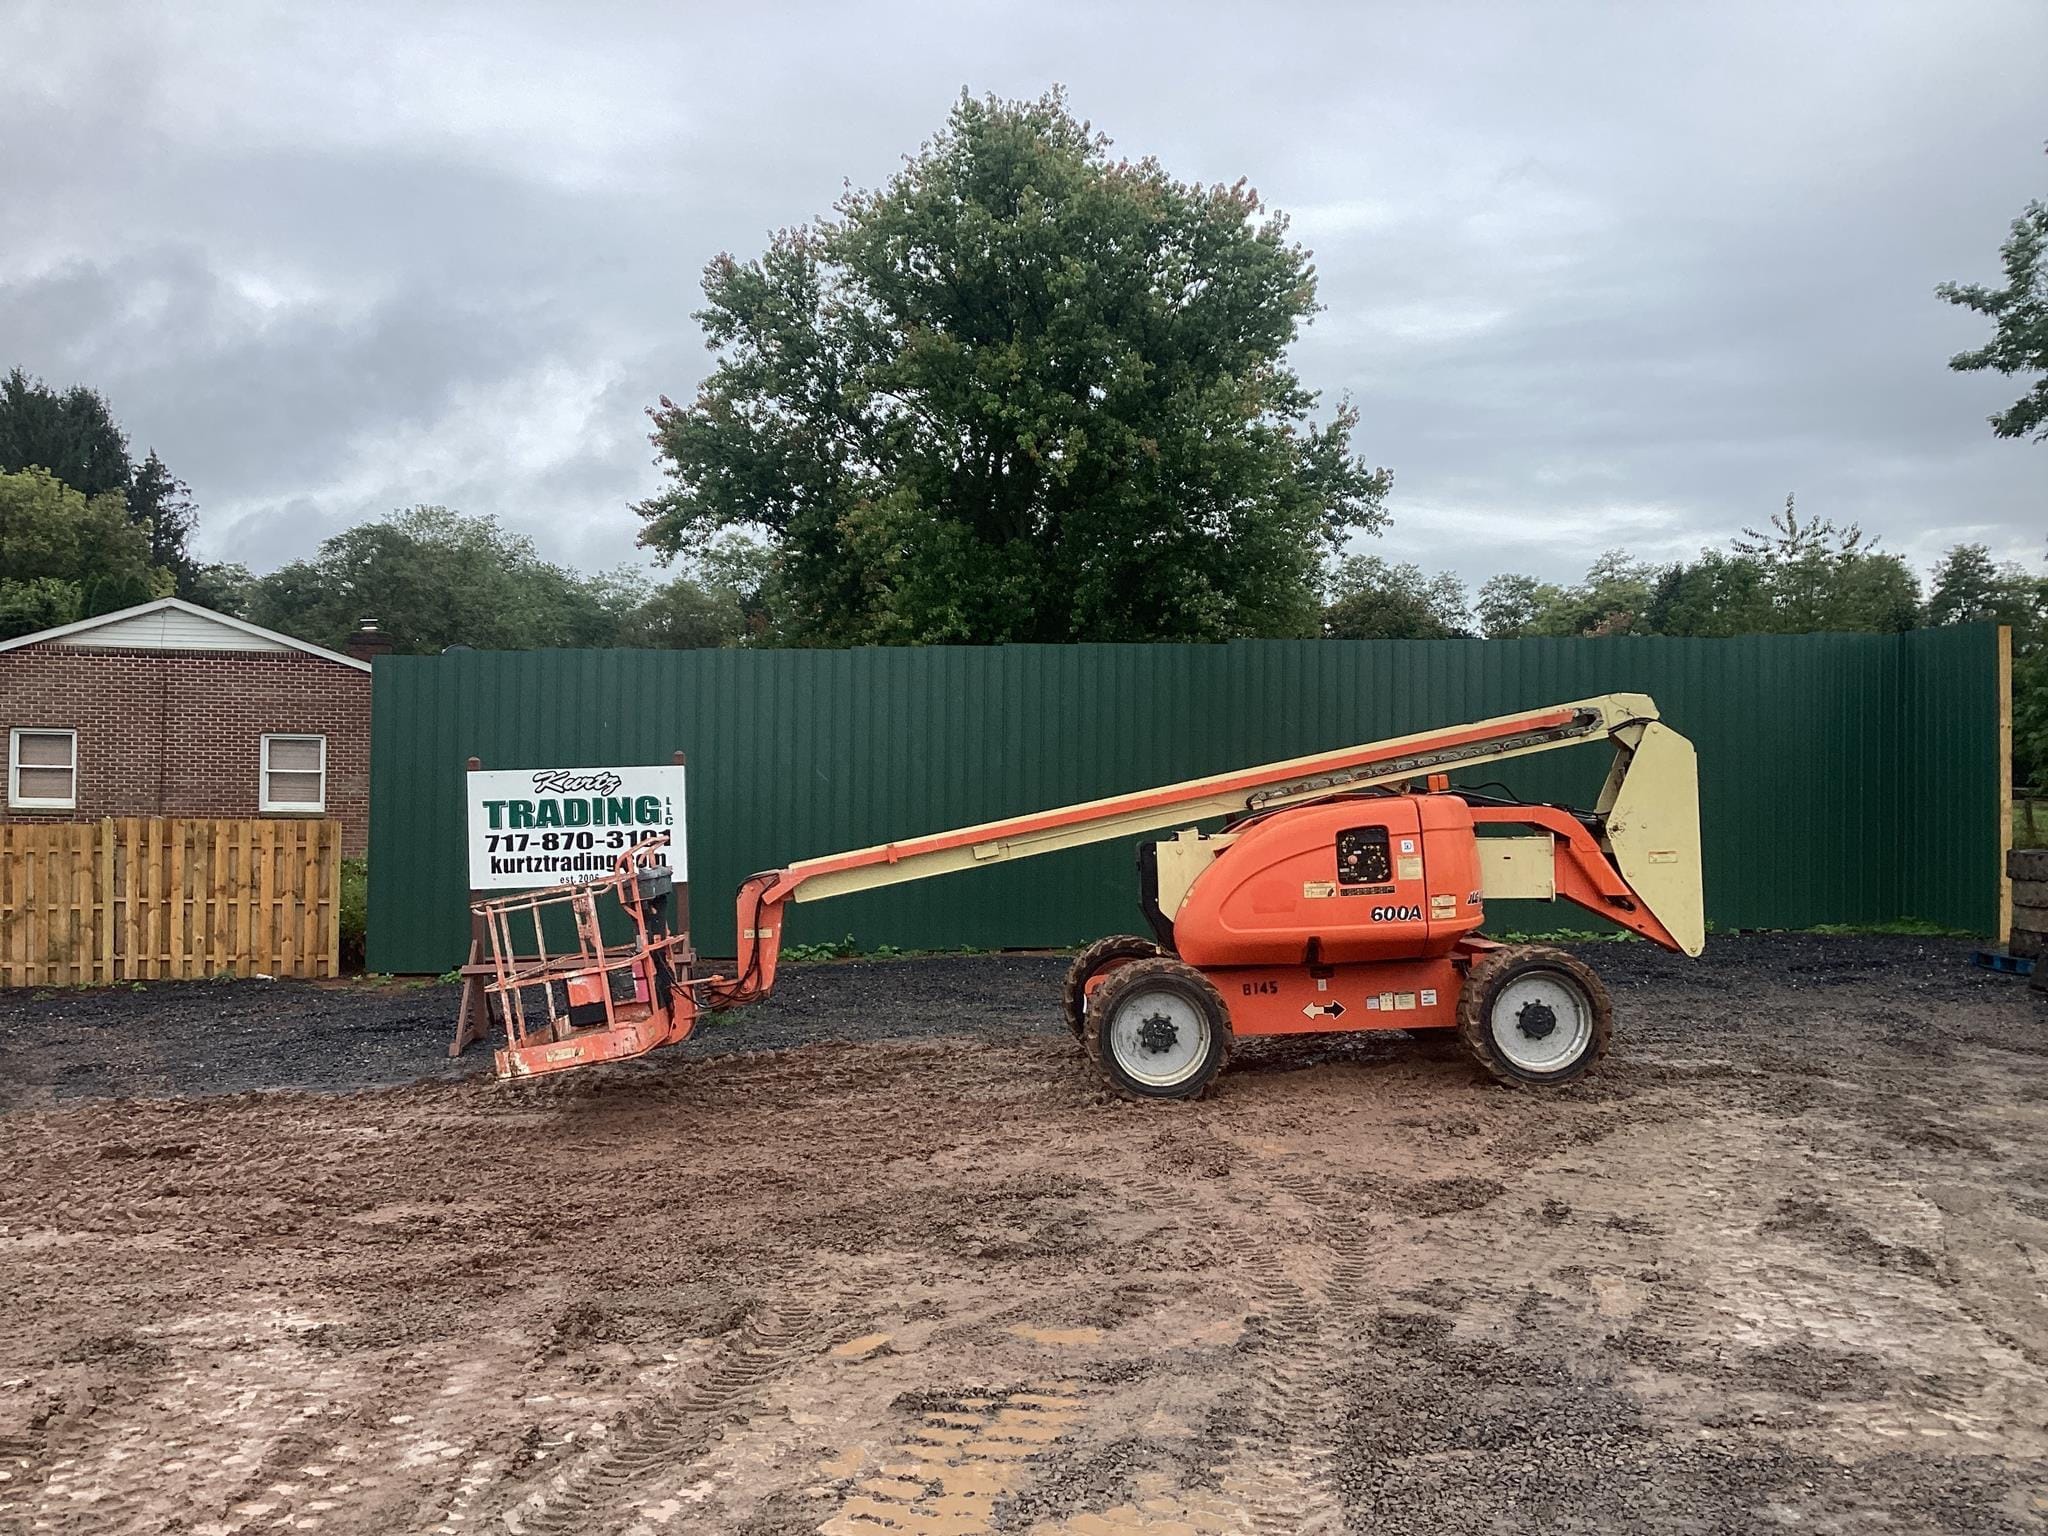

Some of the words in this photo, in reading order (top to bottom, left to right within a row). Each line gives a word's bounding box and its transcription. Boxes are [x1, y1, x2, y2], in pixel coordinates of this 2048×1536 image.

[532, 770, 622, 797] Kurtz
[482, 795, 662, 830] TRADING
[665, 796, 674, 826] LLC
[490, 852, 667, 875] kurtztradingcom
[1370, 905, 1423, 923] 600A
